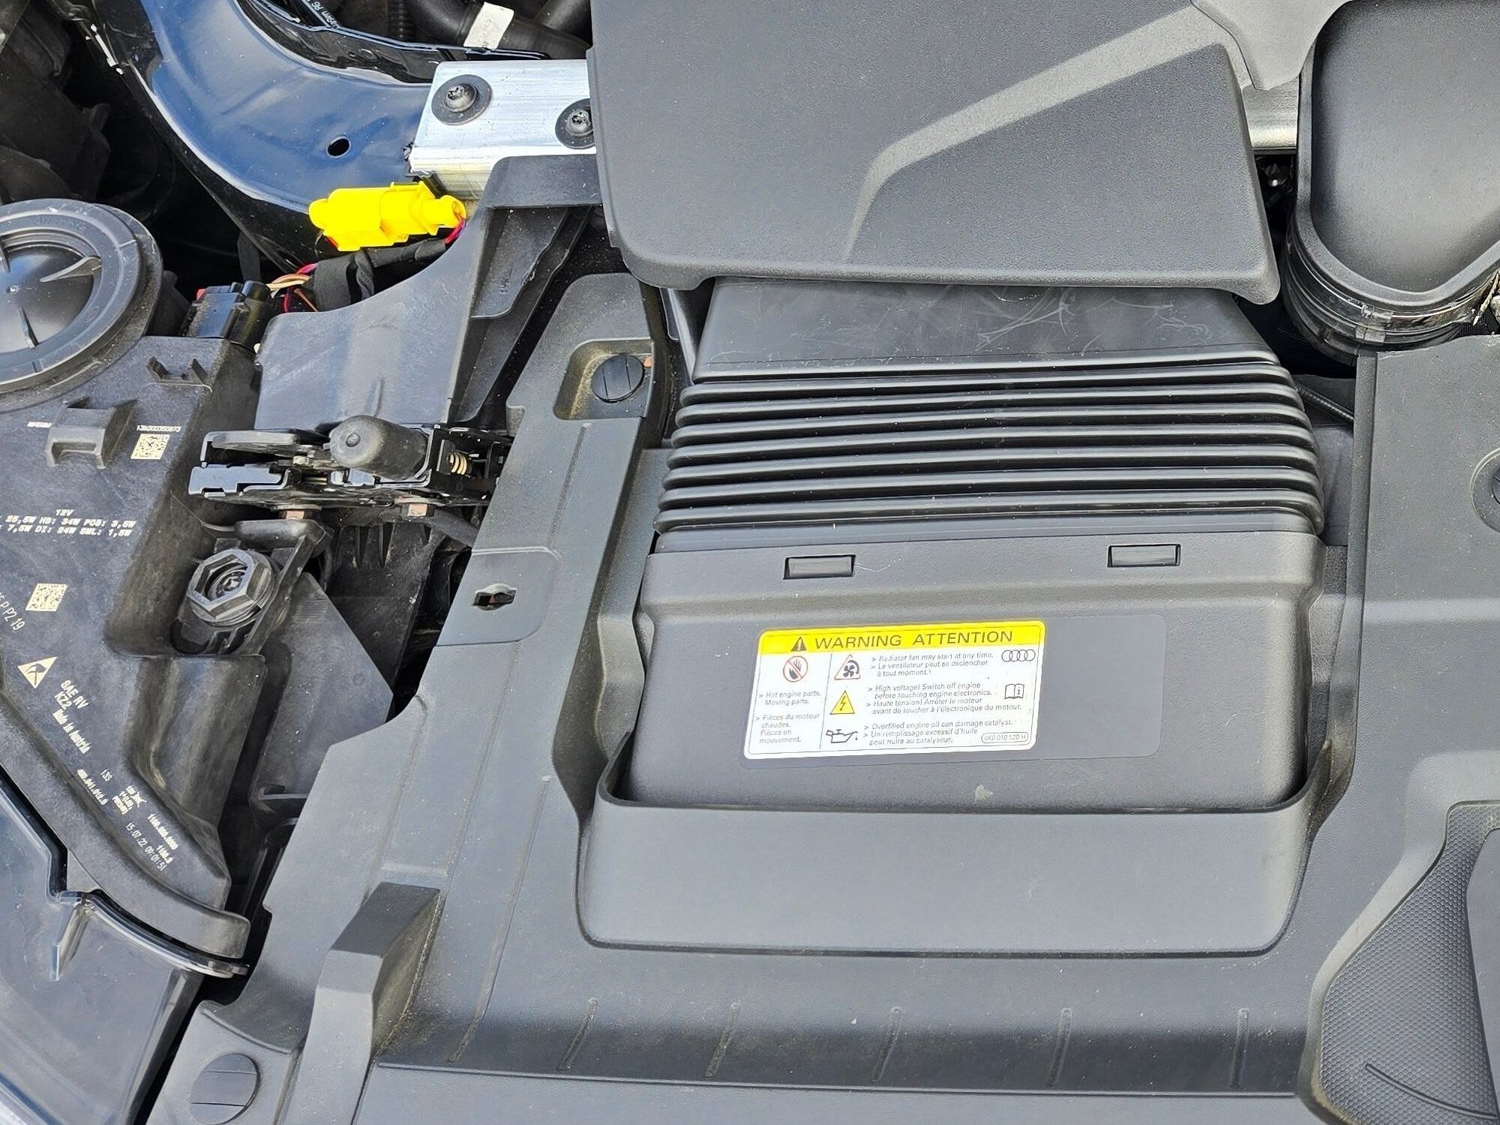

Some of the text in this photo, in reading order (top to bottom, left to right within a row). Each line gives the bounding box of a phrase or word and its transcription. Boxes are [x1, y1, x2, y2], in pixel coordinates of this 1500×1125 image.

[55, 509, 75, 517] 12V
[61, 518, 81, 526] 34W
[83, 519, 107, 527] POS:
[35, 525, 52, 534] DI:
[57, 526, 76, 534] 24W
[4, 607, 17, 621] P2
[11, 618, 26, 630] 19
[815, 631, 1013, 649] WARNING ATTENTION
[875, 685, 891, 693] High
[61, 679, 89, 709] SAE RV
[898, 691, 927, 699] touching
[54, 691, 73, 710] KZ2
[765, 699, 790, 707] Moving
[69, 731, 92, 755] Austria
